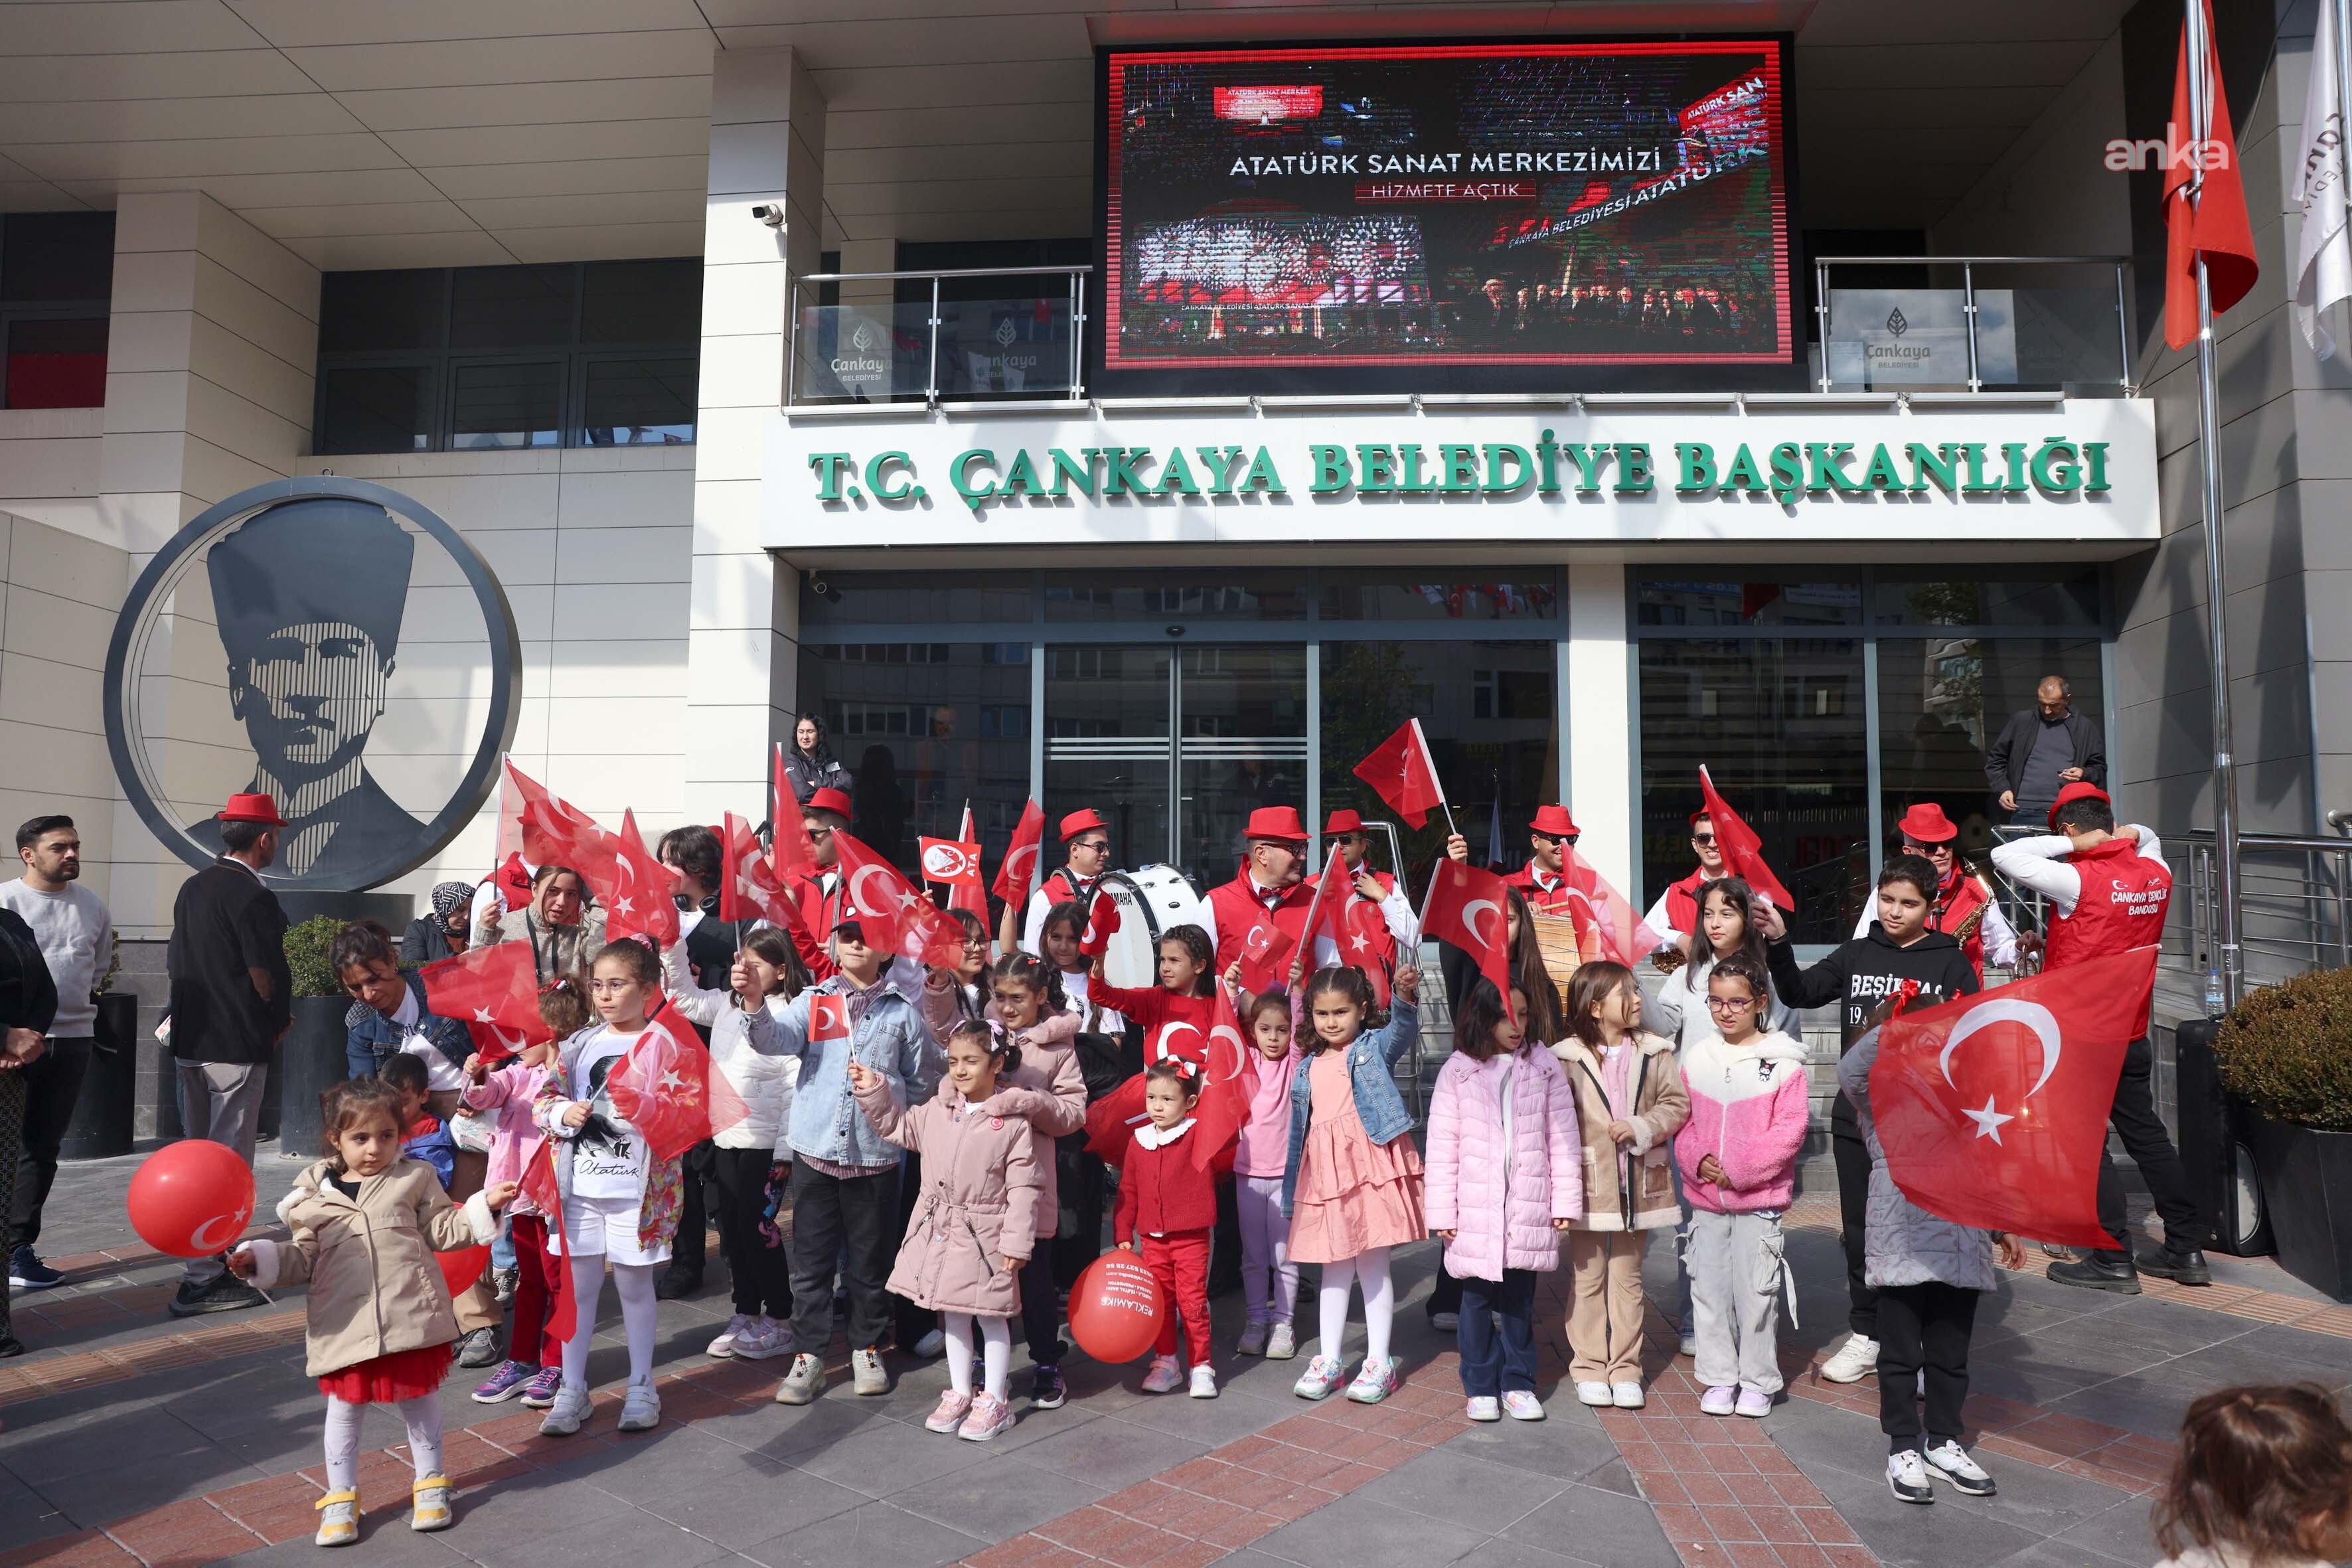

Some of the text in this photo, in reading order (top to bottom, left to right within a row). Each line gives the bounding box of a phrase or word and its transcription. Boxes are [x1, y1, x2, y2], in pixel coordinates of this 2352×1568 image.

[1230, 146, 1661, 175] ATATÜRK SANAT MERKEZİMİZİ
[1463, 183, 1520, 200] AÇTIK
[1551, 193, 1630, 235] BELEDİYESİ
[1865, 343, 1931, 360] Çankaya
[830, 356, 894, 374] Çankaya
[842, 373, 882, 382] BELEDİYESİ
[808, 428, 2112, 510] T.C. ÇANKAYA BELEDİYE BAŞKANLIĞI
[966, 853, 978, 877] ATA
[2111, 888, 2167, 905] ÇANKAYA GENÇLİK
[2128, 903, 2158, 915] BANDOSU
[579, 1159, 639, 1178] Atatürk
